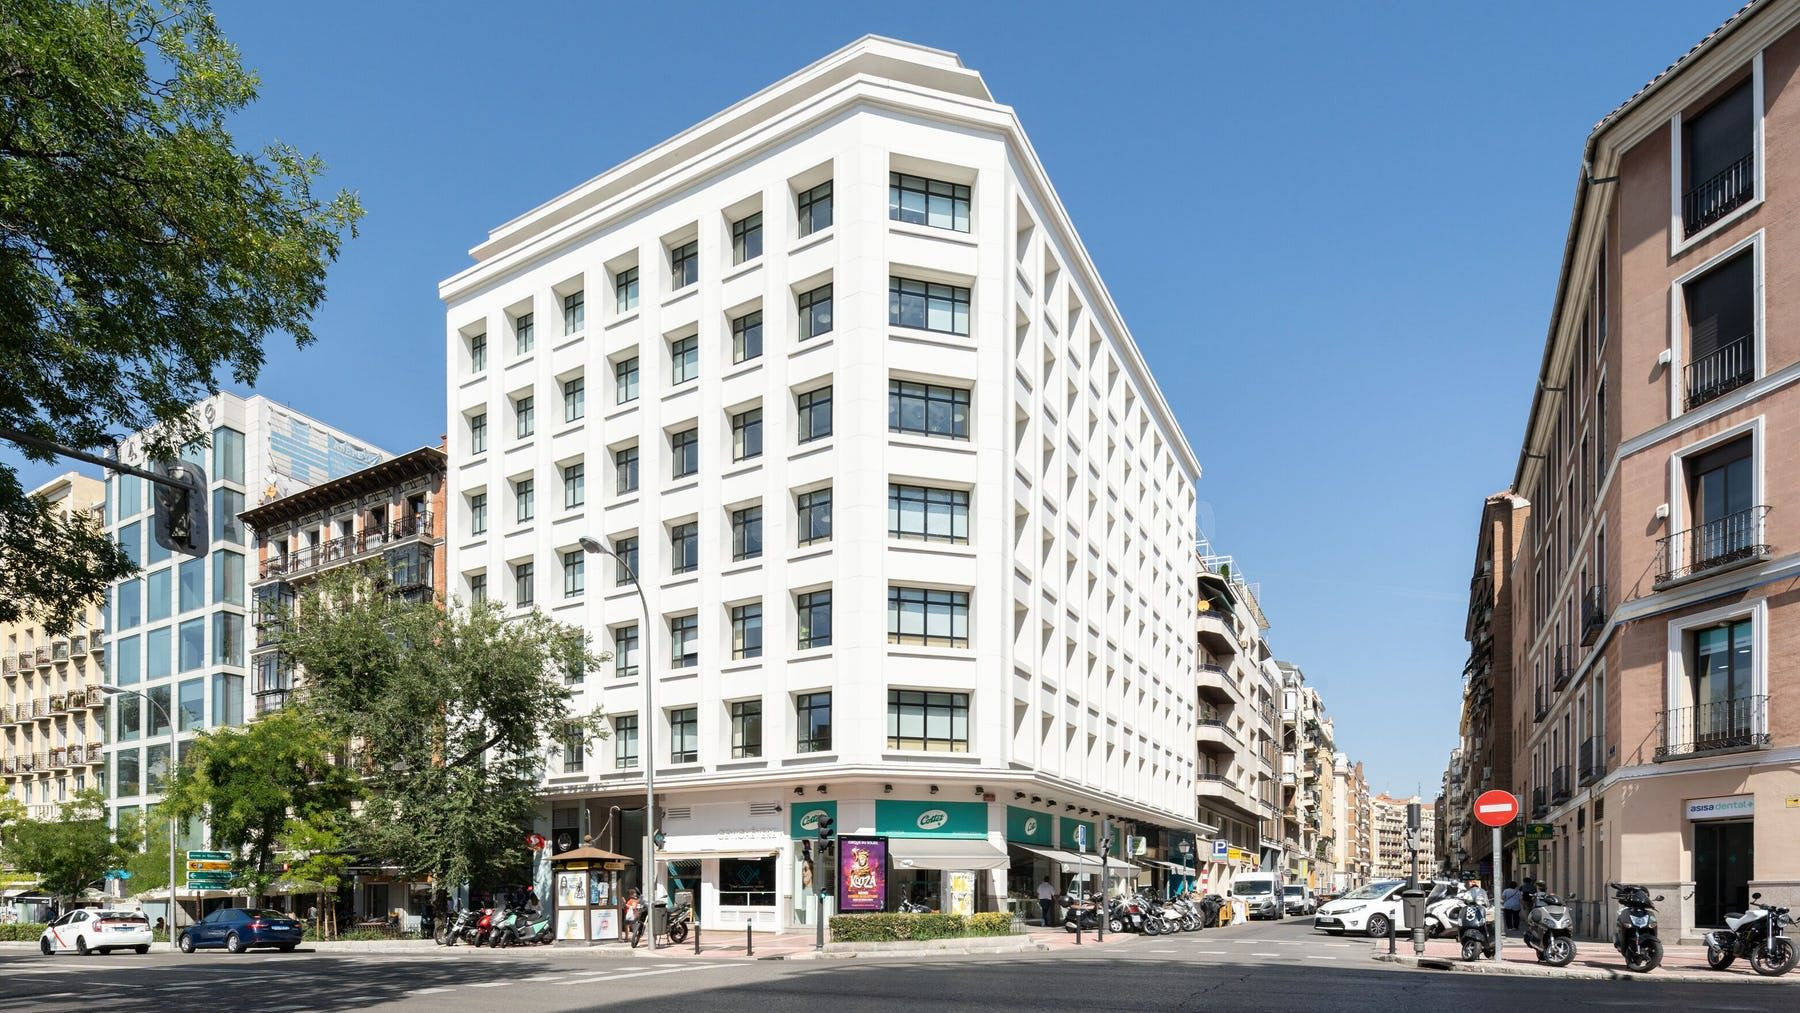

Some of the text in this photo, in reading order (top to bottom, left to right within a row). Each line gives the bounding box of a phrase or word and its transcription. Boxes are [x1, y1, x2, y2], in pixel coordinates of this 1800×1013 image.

[1690, 801, 1747, 812] asisa dental
[1216, 841, 1226, 853] P
